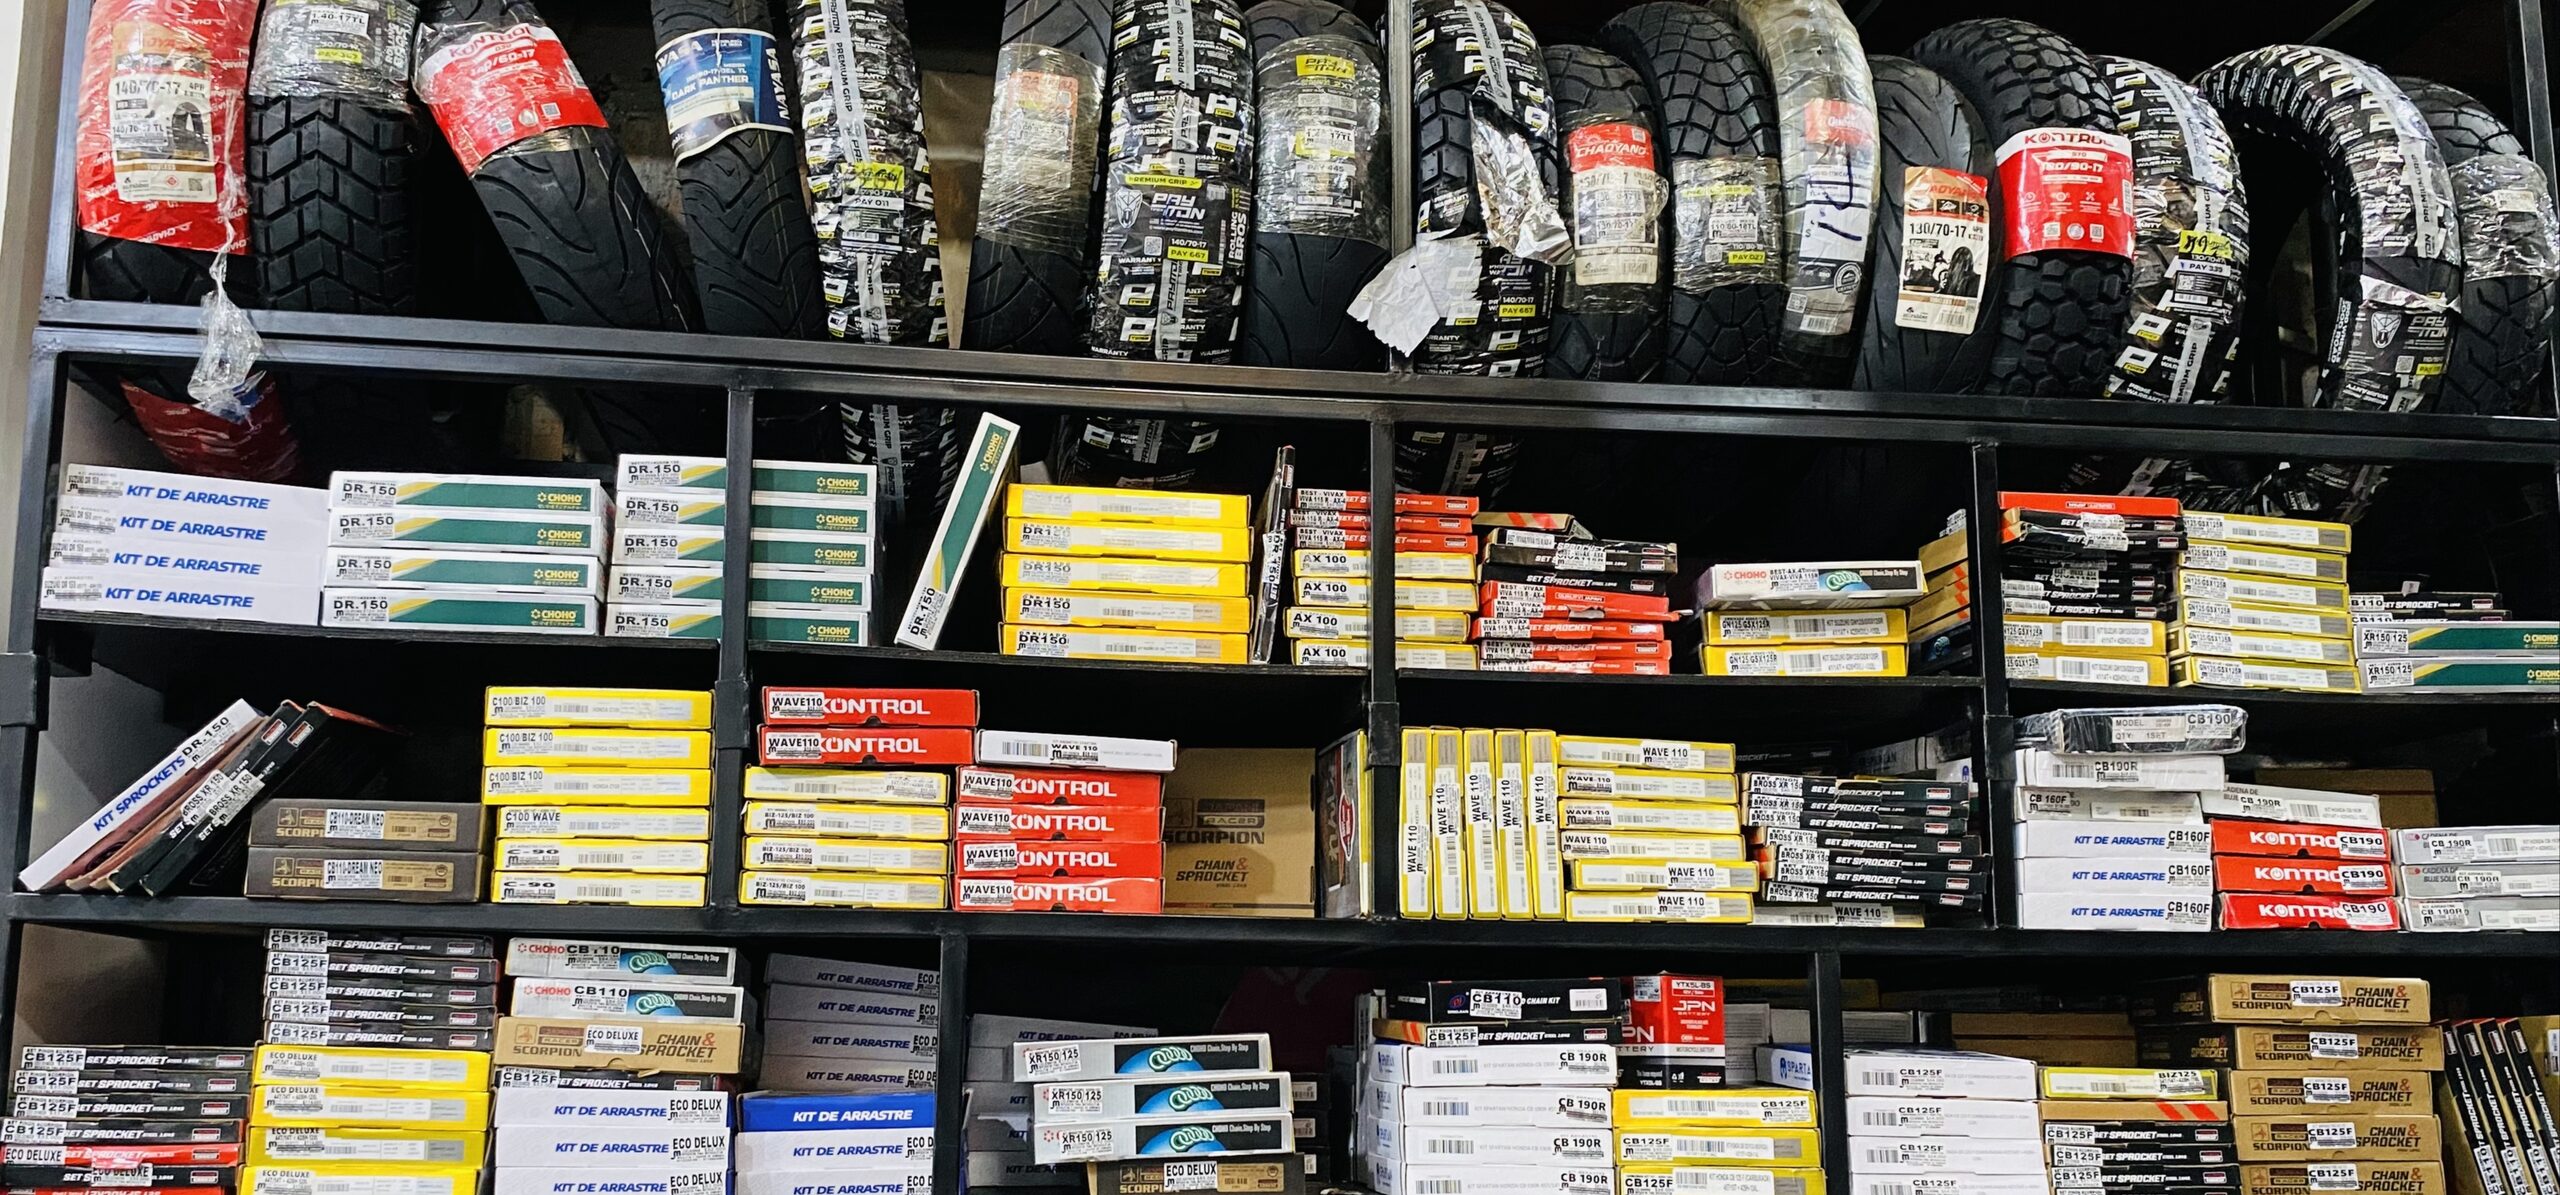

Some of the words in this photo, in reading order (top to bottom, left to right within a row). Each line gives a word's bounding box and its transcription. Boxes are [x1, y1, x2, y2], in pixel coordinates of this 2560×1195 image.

[1178, 20, 1186, 40] GRIP
[1177, 42, 1186, 73] PREMIUM
[836, 42, 850, 84] PREMIUM
[843, 87, 853, 112] GRIP
[672, 82, 696, 100] DARK
[699, 74, 749, 86] PANTHER
[766, 48, 790, 120] NAYASA
[1574, 142, 1647, 158] CHAOYANG
[1129, 176, 1162, 184] PREMIUM
[1165, 178, 1188, 186] GRIP
[1151, 193, 1197, 207] PAY
[1229, 213, 1238, 258] ROLLING
[1909, 222, 1967, 237] 130/70-17
[1235, 212, 1246, 261] BROS
[1171, 239, 1207, 248] 140/70-17
[1170, 250, 1187, 259] PAY
[1118, 257, 1161, 265] WARRANTY
[1166, 261, 1178, 310] PAYTON
[2186, 342, 2197, 365] GRIP
[982, 434, 1002, 465] CHOHO
[628, 464, 681, 475] DR.150
[343, 482, 397, 496] DR.150
[826, 478, 859, 488] CHOHO
[126, 484, 153, 498] KIT
[156, 486, 181, 501] DE
[183, 489, 270, 510] ARRASTRE
[547, 493, 582, 504] CHOHO
[626, 501, 679, 513] DR.150
[826, 515, 859, 525] CHOHO
[120, 516, 148, 530] KIT
[151, 518, 176, 532] DE
[178, 521, 268, 542] ARRASTRE
[624, 537, 678, 548] DR.150
[824, 549, 857, 559] CHOHO
[1303, 554, 1320, 564] AX
[1325, 554, 1347, 564] 100
[337, 558, 392, 570] DR.150
[544, 570, 580, 580] CHOHO
[1734, 571, 1767, 580] CHOHO
[105, 587, 133, 601] KIT
[136, 588, 161, 603] DE
[164, 591, 254, 609] ARRASTRE
[1022, 598, 1070, 610] DR150
[333, 599, 389, 611] DR.150
[541, 610, 577, 620] CHOHO
[909, 588, 936, 636] DR.150
[615, 616, 668, 628] DR.150
[1293, 613, 1312, 625] AX
[1316, 616, 1338, 627] 100
[817, 626, 851, 636] CHOHO
[1303, 648, 1321, 658] AX
[1325, 648, 1346, 658] 100
[532, 696, 546, 705] 100
[772, 697, 822, 707] WAVE110
[822, 698, 930, 715] KONTROL
[2188, 714, 2230, 724] CB190
[181, 716, 230, 757] DR.150
[768, 737, 820, 747] WAVE110
[819, 737, 927, 753] KONTROL
[1051, 743, 1076, 751] WAVE
[1642, 747, 1669, 757] WAVE
[1672, 748, 1688, 758] 110
[2094, 761, 2138, 771] CB190R
[964, 775, 1013, 788] WAVE110
[1535, 776, 1544, 789] 110
[93, 810, 116, 833] KIT
[116, 754, 187, 815] SPROCKETS
[1012, 779, 1117, 797] KONTROL
[1436, 787, 1446, 800] 110
[2029, 794, 2044, 803] CB
[2046, 795, 2067, 804] 160F
[1535, 792, 1544, 823] WAVE
[505, 812, 530, 822] C100
[533, 812, 560, 821] WAVE
[1439, 803, 1448, 835] WAVE
[1408, 825, 1418, 839] 110
[2168, 830, 2210, 841] CB160F
[1825, 838, 1841, 847] SET
[1843, 839, 1891, 850] SPROCKET
[2074, 835, 2091, 844] KIT
[2093, 836, 2109, 845] DE
[2111, 836, 2166, 846] ARRASTRE
[2340, 836, 2383, 846] CB190
[1194, 860, 1235, 870] CHAIN
[1236, 857, 1248, 870] &
[1408, 843, 1418, 873] WAVE
[1176, 871, 1249, 882] SPROCKET
[963, 884, 1012, 895] WAVE110
[1013, 885, 1116, 902] KONTROL
[271, 934, 327, 946] CB125F
[534, 986, 571, 996] CHOHO
[574, 986, 627, 997] CB110
[2291, 986, 2339, 994] CB125F
[2355, 987, 2394, 998] CHAIN
[2396, 985, 2408, 998] &
[1471, 993, 1521, 1006] CB110
[1526, 996, 1548, 1005] CHAIN
[2231, 1001, 2292, 1010] SCORPION
[2341, 997, 2410, 1009] SPROCKET
[1672, 1000, 1716, 1012] JPN
[587, 1029, 604, 1040] ECO
[606, 1030, 639, 1041] DELUXE
[657, 1034, 701, 1046] CHAIN
[703, 1033, 716, 1045] &
[1429, 1031, 1476, 1042] CB125F
[1479, 1033, 1494, 1041] SET
[1495, 1031, 1545, 1041] SPROCKET
[512, 1045, 581, 1057] SCORPION
[641, 1044, 717, 1059] SPROCKET
[24, 1052, 85, 1063] CB125F
[86, 1056, 105, 1065] SET
[106, 1056, 168, 1065] SPROCKET
[1560, 1053, 1575, 1063] CB
[1577, 1053, 1607, 1063] 190R
[1900, 1068, 1943, 1076] CB125F
[2158, 1071, 2197, 1080] BIZ125
[554, 1105, 573, 1115] KIT
[577, 1106, 597, 1116] DE
[600, 1107, 668, 1117] ARRASTRE
[1760, 1101, 1807, 1109] CB125F
[793, 1110, 816, 1122] KIT
[818, 1110, 838, 1122] DE
[839, 1108, 914, 1122] ARRASTRE
[5, 1150, 26, 1161] ECO
[28, 1149, 62, 1161] DELUXE
[2056, 1151, 2102, 1160] CB125F
